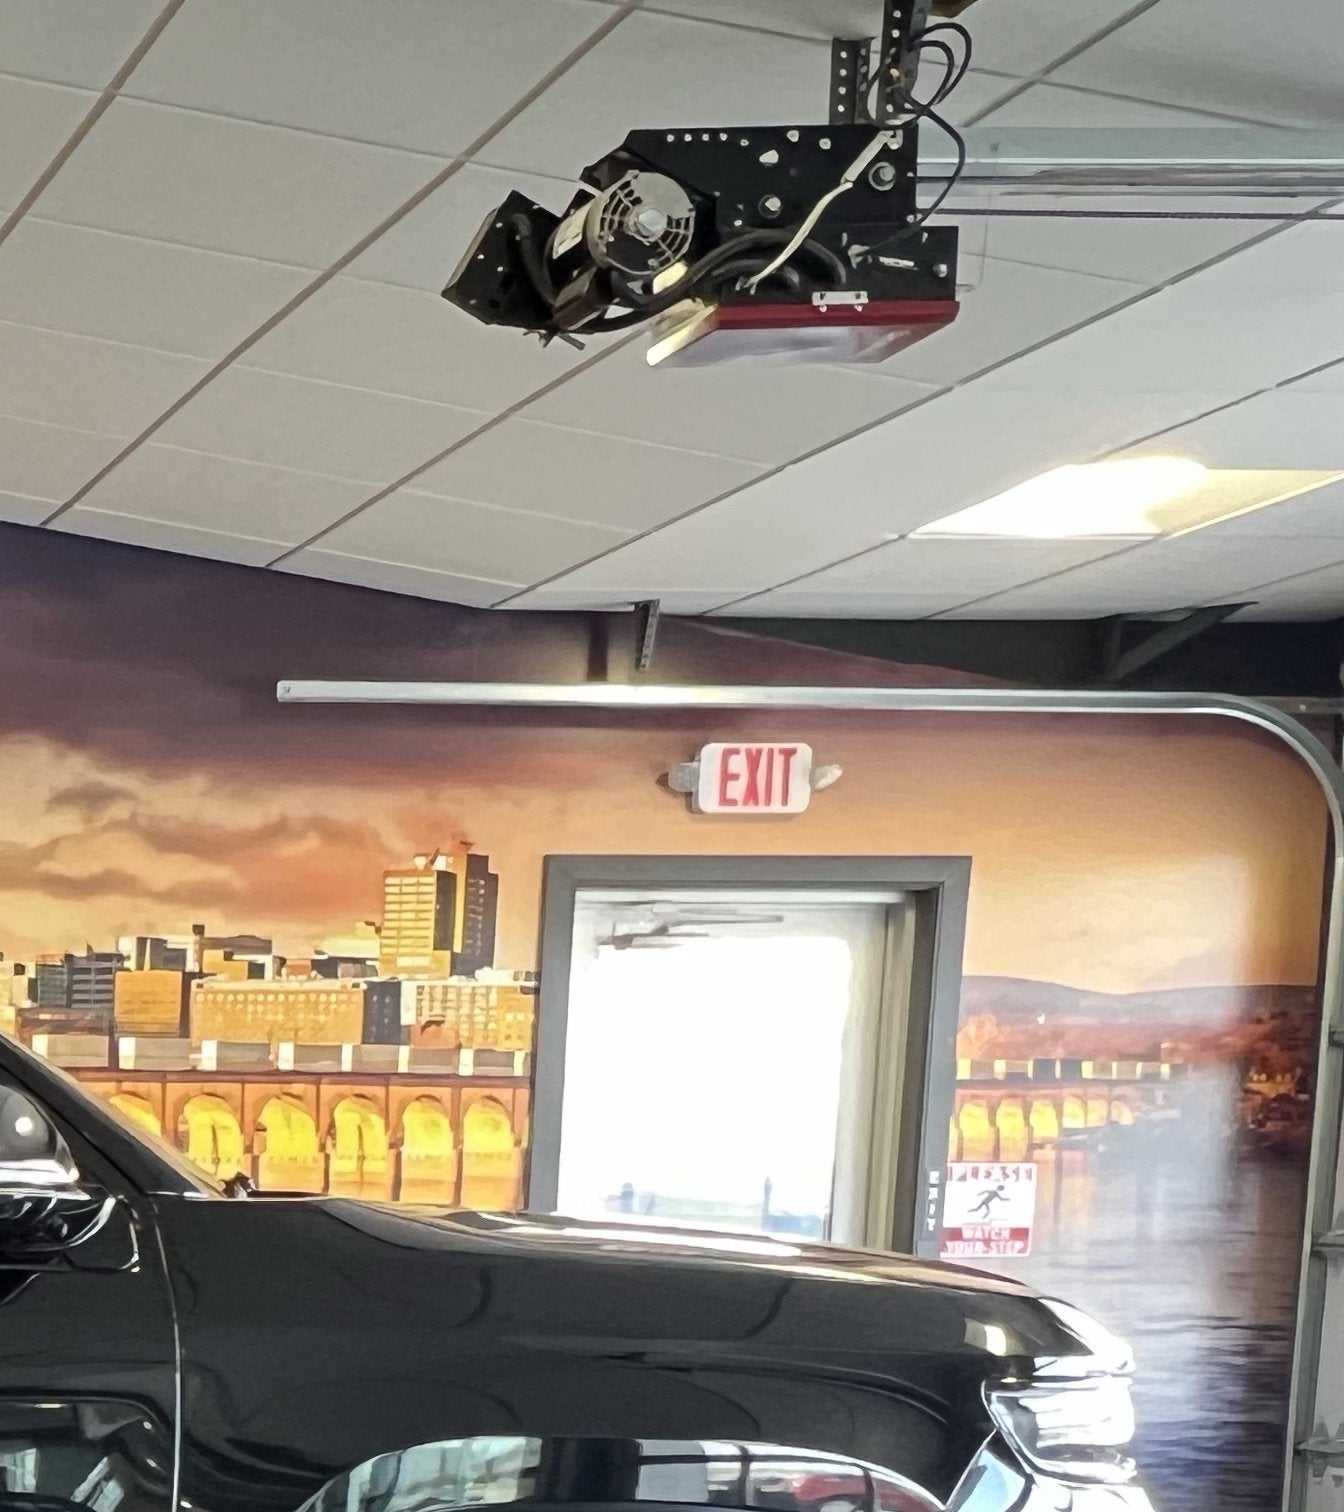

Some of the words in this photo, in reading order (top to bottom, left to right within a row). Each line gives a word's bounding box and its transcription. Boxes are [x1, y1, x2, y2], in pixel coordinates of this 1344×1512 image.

[719, 748, 798, 806] EXIT
[950, 1166, 1030, 1182] PLEASE
[961, 1227, 1011, 1240] WATCH
[946, 1240, 985, 1254] YOUR
[990, 1240, 1024, 1254] STEP
